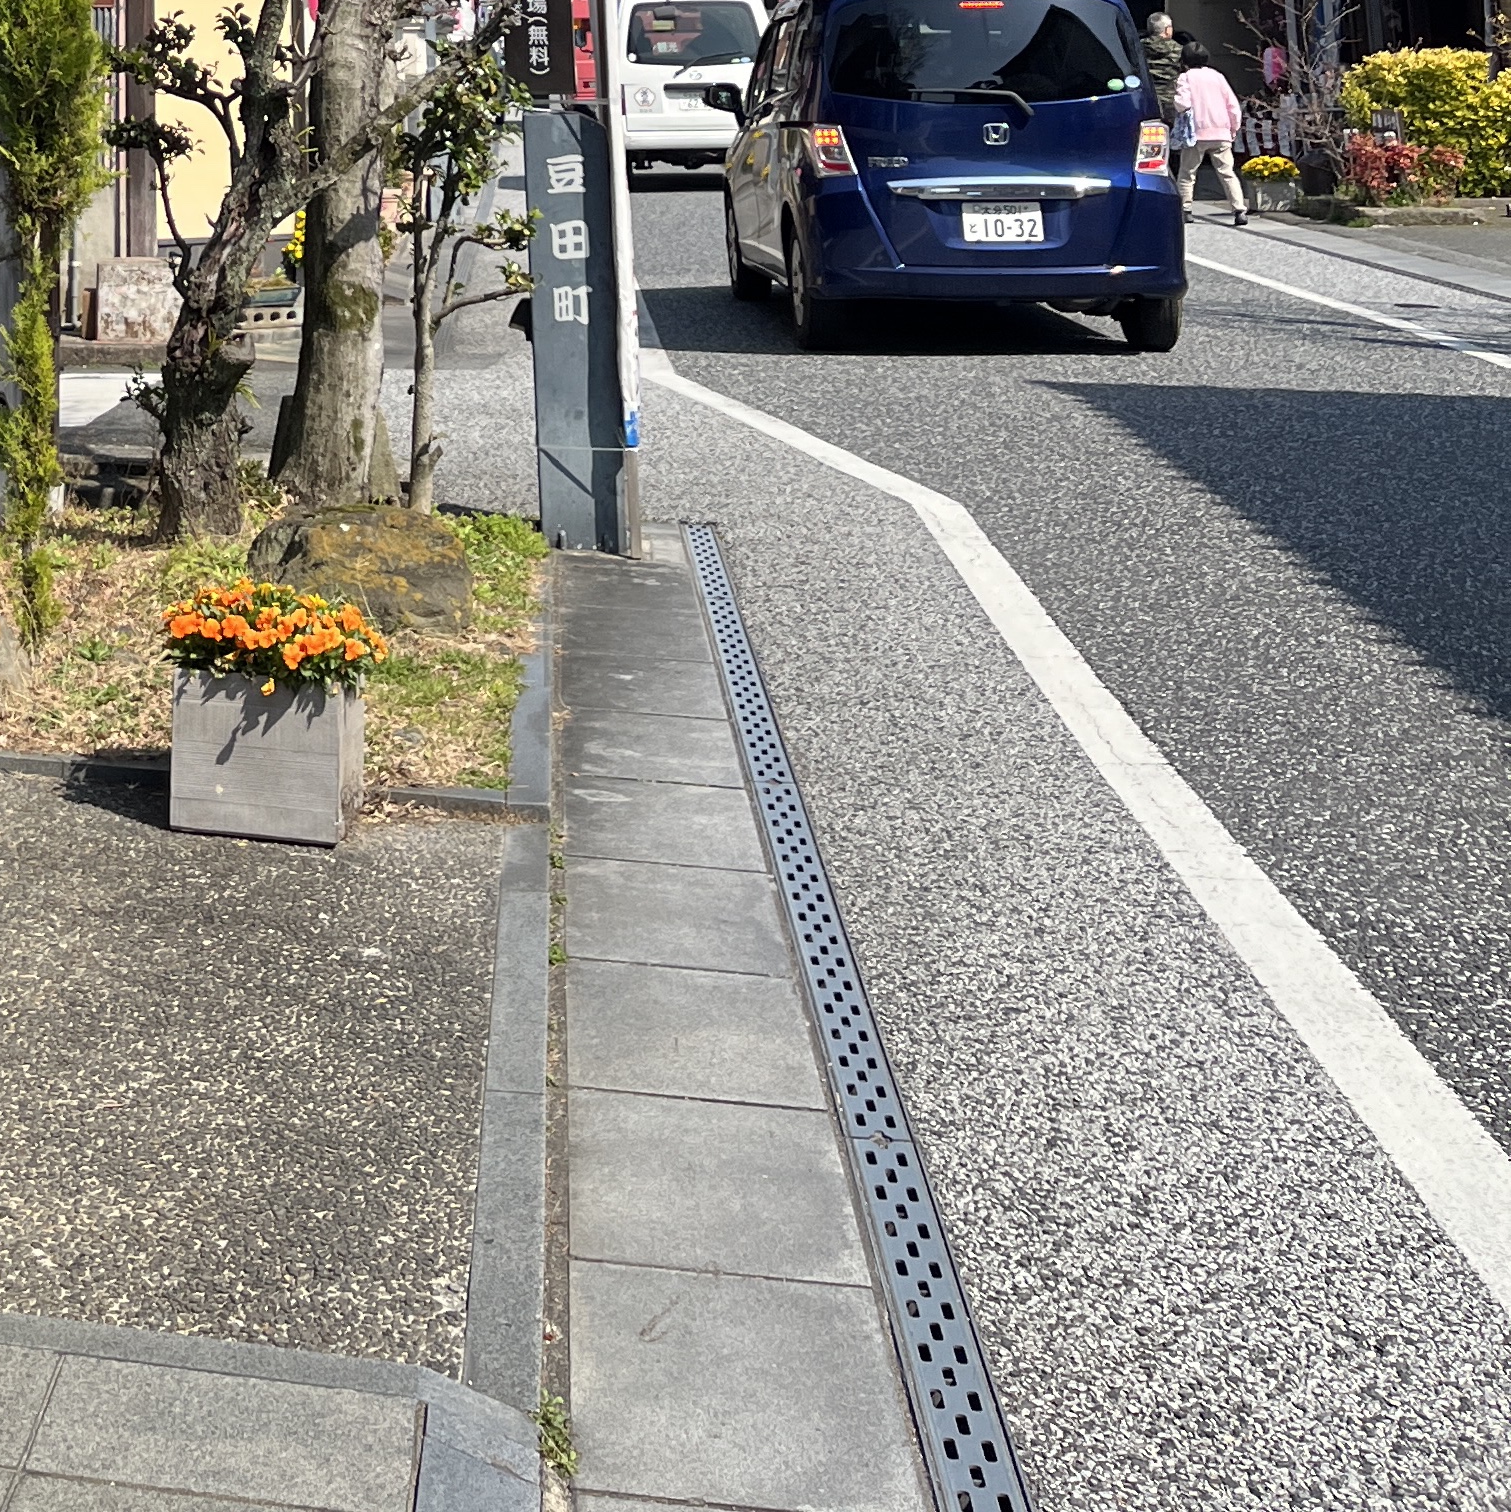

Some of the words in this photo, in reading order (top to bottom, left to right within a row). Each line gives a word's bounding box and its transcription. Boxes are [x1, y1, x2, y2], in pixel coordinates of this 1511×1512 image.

[546, 154, 593, 326] 豆田町
[983, 219, 1039, 238] 10-32
